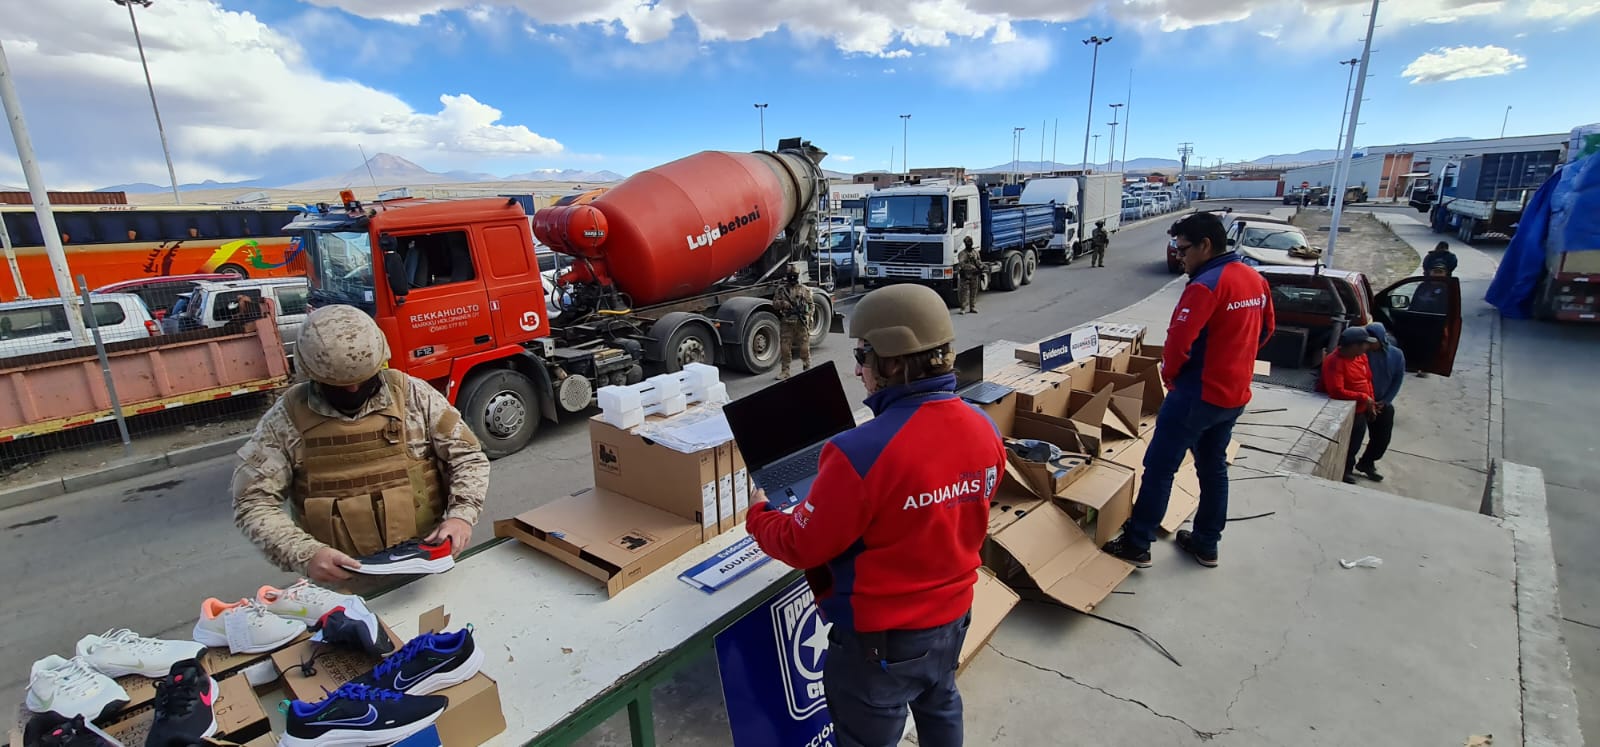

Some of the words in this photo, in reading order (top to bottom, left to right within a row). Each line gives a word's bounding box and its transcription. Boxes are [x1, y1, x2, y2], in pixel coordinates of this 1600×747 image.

[686, 205, 761, 251] Lujabetoni
[409, 304, 480, 323] REKKAHUOLTO
[1226, 297, 1261, 311] ADUANAS
[1042, 344, 1068, 361] Evidencia
[903, 479, 981, 510] ADUANAS
[719, 545, 764, 574] ADUANA
